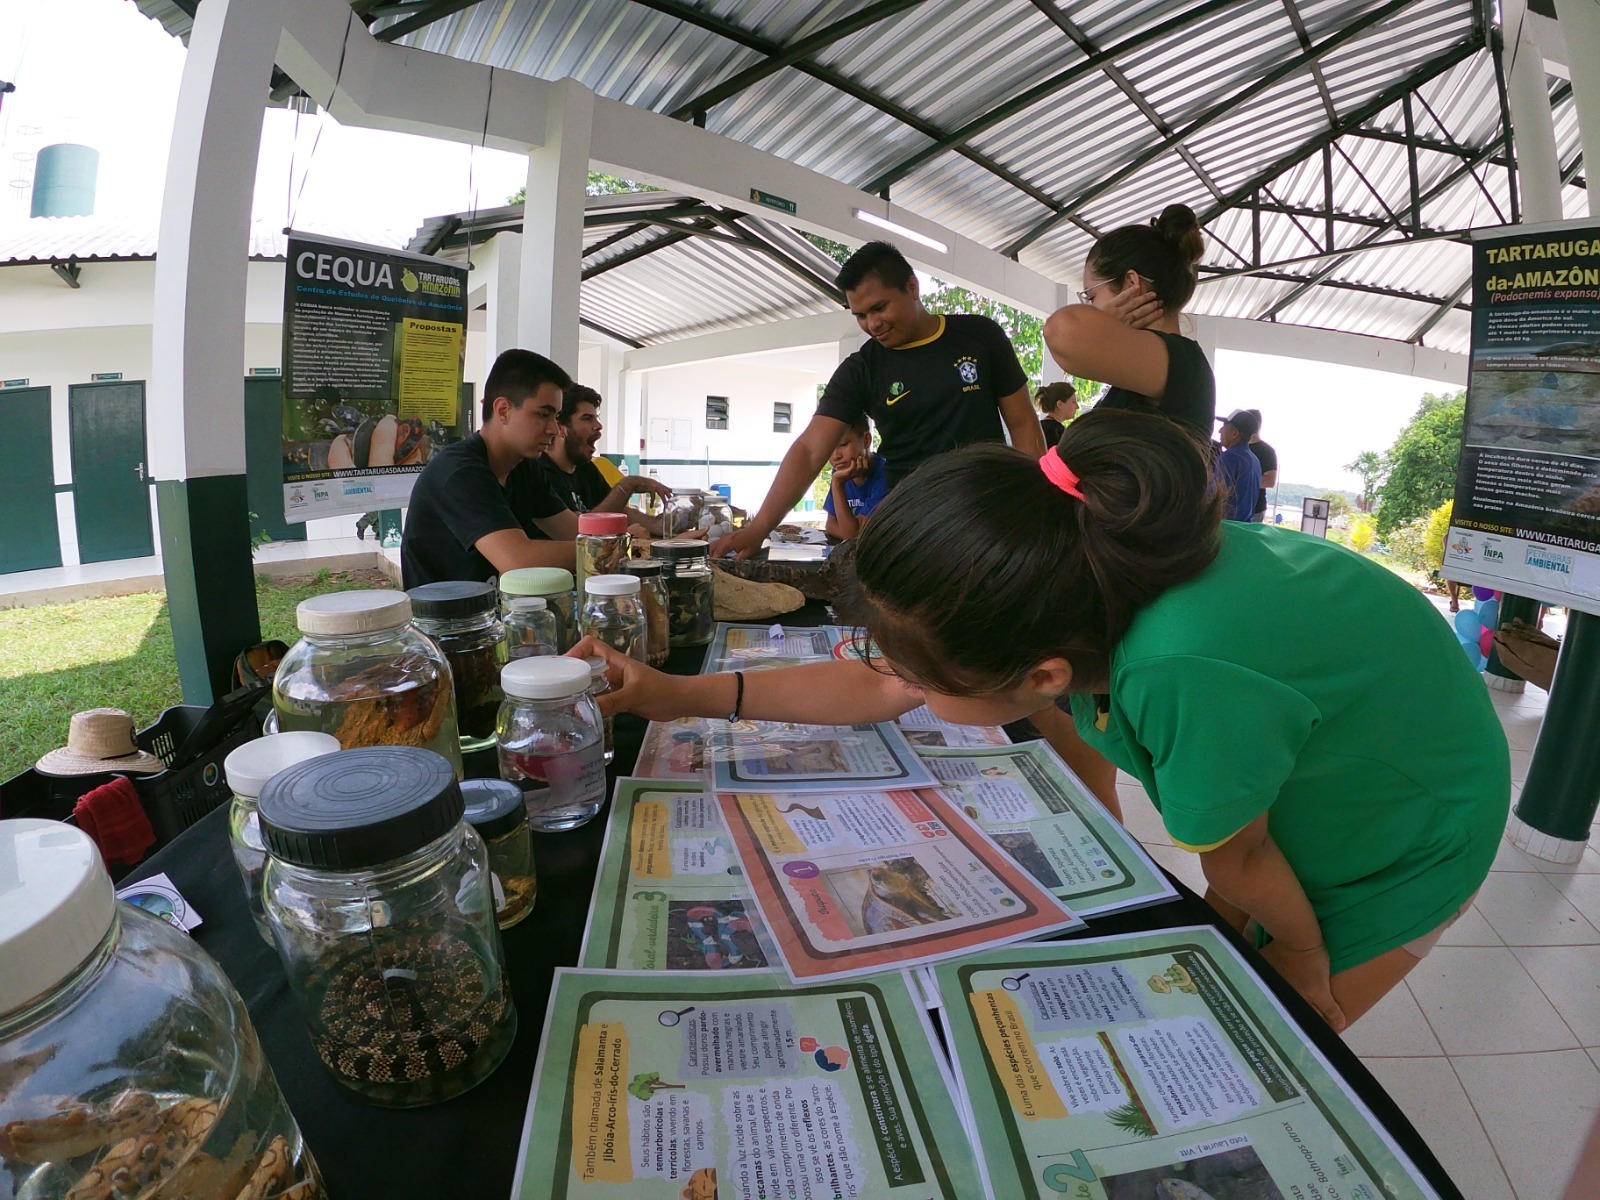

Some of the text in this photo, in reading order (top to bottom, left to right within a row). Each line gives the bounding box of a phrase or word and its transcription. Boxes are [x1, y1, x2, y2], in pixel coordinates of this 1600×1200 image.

[296, 251, 394, 290] CEQUA
[419, 271, 461, 287] TARTARUGAS
[297, 285, 324, 294] Centro
[338, 289, 369, 300] Estudos
[428, 300, 463, 311] Amazônia
[1491, 289, 1551, 304] (Podocnemis
[409, 321, 457, 334] Propostas
[962, 385, 981, 393] BRASIL
[344, 487, 373, 495] AMBIENTAL
[1454, 519, 1472, 528] VISITE
[1479, 523, 1499, 532] NOSSO
[1500, 525, 1514, 535] SITE:
[1484, 548, 1504, 560] INPA
[1528, 549, 1572, 564] PETROBRAS
[1527, 557, 1570, 574] AMBIENTAL
[632, 891, 667, 902] 3
[699, 1010, 708, 1032] pardo-
[986, 992, 1009, 1037] peçonhentas
[724, 1018, 733, 1039] negras
[770, 1010, 786, 1068] aproximadamente
[853, 1035, 861, 1043] de
[700, 1033, 708, 1052] dorso
[712, 1026, 721, 1072] avermelhado
[746, 1012, 760, 1068] Seu comprimento
[763, 1041, 773, 1058] pode
[1004, 1010, 1042, 1090] que ocorrem no Brasil
[594, 1030, 607, 1075] Salamanta
[725, 1040, 734, 1070] manchas
[856, 1044, 870, 1073] alimenta
[1002, 1039, 1019, 1072] espécies
[592, 1077, 602, 1088] de
[865, 1075, 873, 1083] se
[1014, 1074, 1025, 1088] das
[1061, 1075, 1073, 1093] sobre
[603, 1038, 621, 1162] Jibóia-Arco-íris-do-Cerrado
[732, 1090, 739, 1099] as
[784, 1086, 792, 1098] Por
[1020, 1090, 1032, 1108] uma
[1069, 1094, 1078, 1108] Vive
[588, 1091, 601, 1132] chamada
[682, 1106, 690, 1135] savanas
[733, 1101, 742, 1122] sobre
[760, 1095, 772, 1132] espectros,
[788, 1101, 800, 1137] diferente.
[815, 1106, 823, 1116] do
[870, 1090, 888, 1134] constritora
[640, 1104, 650, 1167] Seus hábitos são
[668, 1094, 677, 1179] terrícolas, vivendo em
[696, 1119, 704, 1150] campos.
[735, 1124, 744, 1147] incide
[818, 1117, 828, 1138] cores
[832, 1121, 844, 1144] nome
[654, 1107, 663, 1171] semiarborícolas
[746, 1094, 766, 1199] escamas do animal, ela se
[765, 1134, 775, 1159] vários
[771, 1090, 796, 1200] cada comprimento de onda
[794, 1138, 803, 1152] cor
[800, 1099, 823, 1183] isso se vê os reflexos
[823, 1140, 831, 1149] as
[1203, 1140, 1228, 1150] Laurie
[1229, 1135, 1248, 1144] Foto
[583, 1135, 596, 1178] Também
[681, 1137, 691, 1172] florestas,
[738, 1149, 746, 1161] luz
[797, 1153, 806, 1172] uma
[838, 1145, 848, 1161] dão
[886, 1142, 900, 1172] espécie
[1179, 1148, 1196, 1156] Vitt
[1282, 1121, 1329, 1183] Bothrops atrox
[769, 1163, 777, 1176] em
[826, 1152, 842, 1200] brilhantes,
[842, 1163, 853, 1179] que
[1043, 1148, 1098, 1193] 2
[1334, 1156, 1350, 1176] INPA
[739, 1170, 750, 1200] uando
[770, 1178, 781, 1200] ivide
